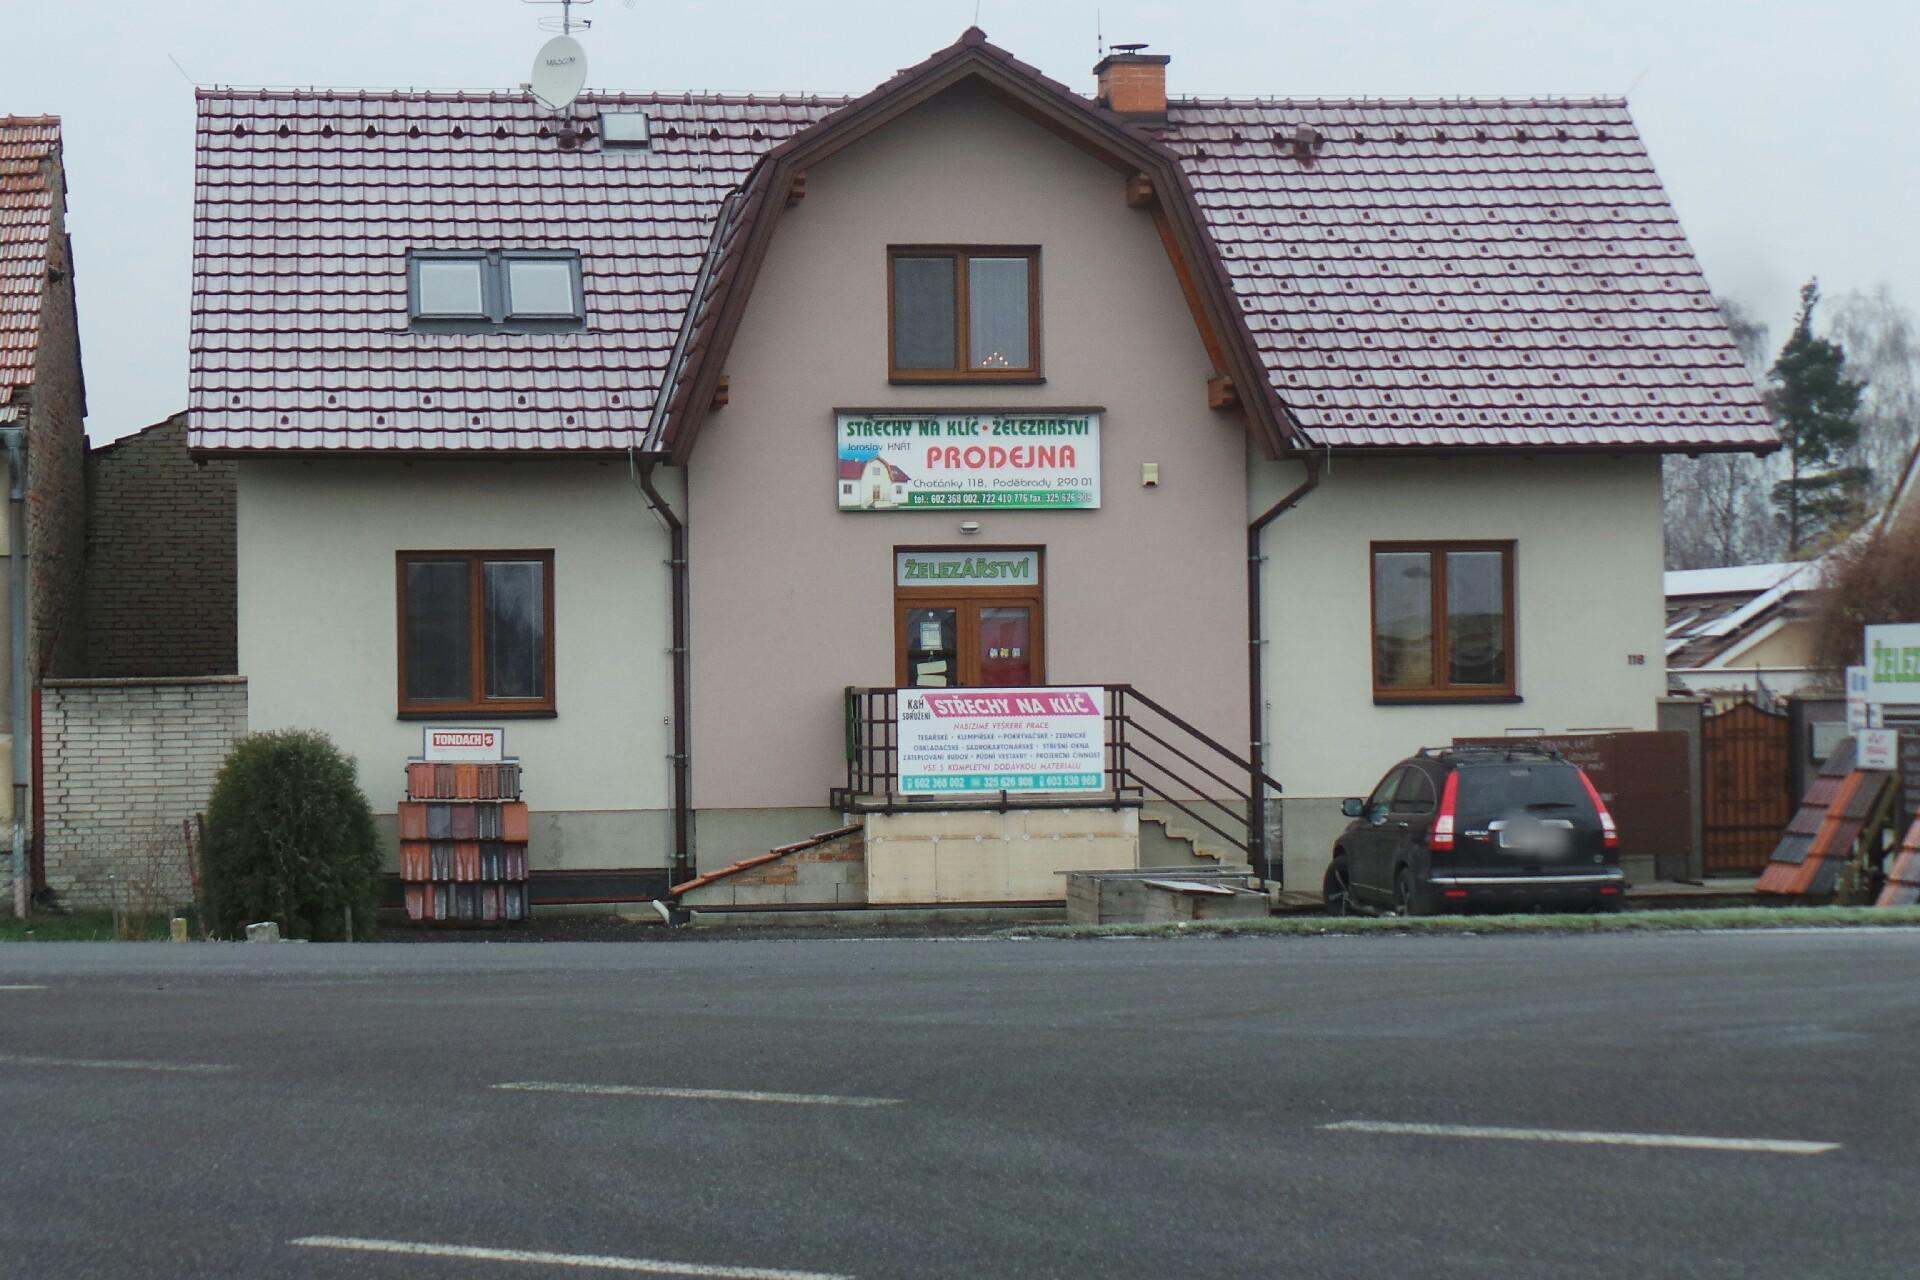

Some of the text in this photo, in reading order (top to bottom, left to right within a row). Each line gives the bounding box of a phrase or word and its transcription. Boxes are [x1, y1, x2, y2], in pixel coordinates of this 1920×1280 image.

[918, 419, 941, 437] NA
[947, 415, 980, 436] KLÍČ
[847, 441, 883, 452] Jaroslav
[926, 444, 1077, 470] PRODEJNA
[993, 475, 1051, 489] Poděbrady
[1057, 477, 1078, 487] 290
[1080, 476, 1092, 487] 01
[931, 494, 946, 504] 602
[947, 494, 962, 504] 368
[982, 493, 996, 504] 722
[997, 493, 1012, 503] 410
[1014, 493, 1028, 503] 776
[904, 557, 1029, 578] ŽELEZÁŘSTVÍ
[1627, 654, 1646, 666] 118
[907, 699, 924, 710] K&H
[935, 693, 1089, 715] STŘECHY NA KLÍČ
[434, 734, 482, 745] TONDACH
